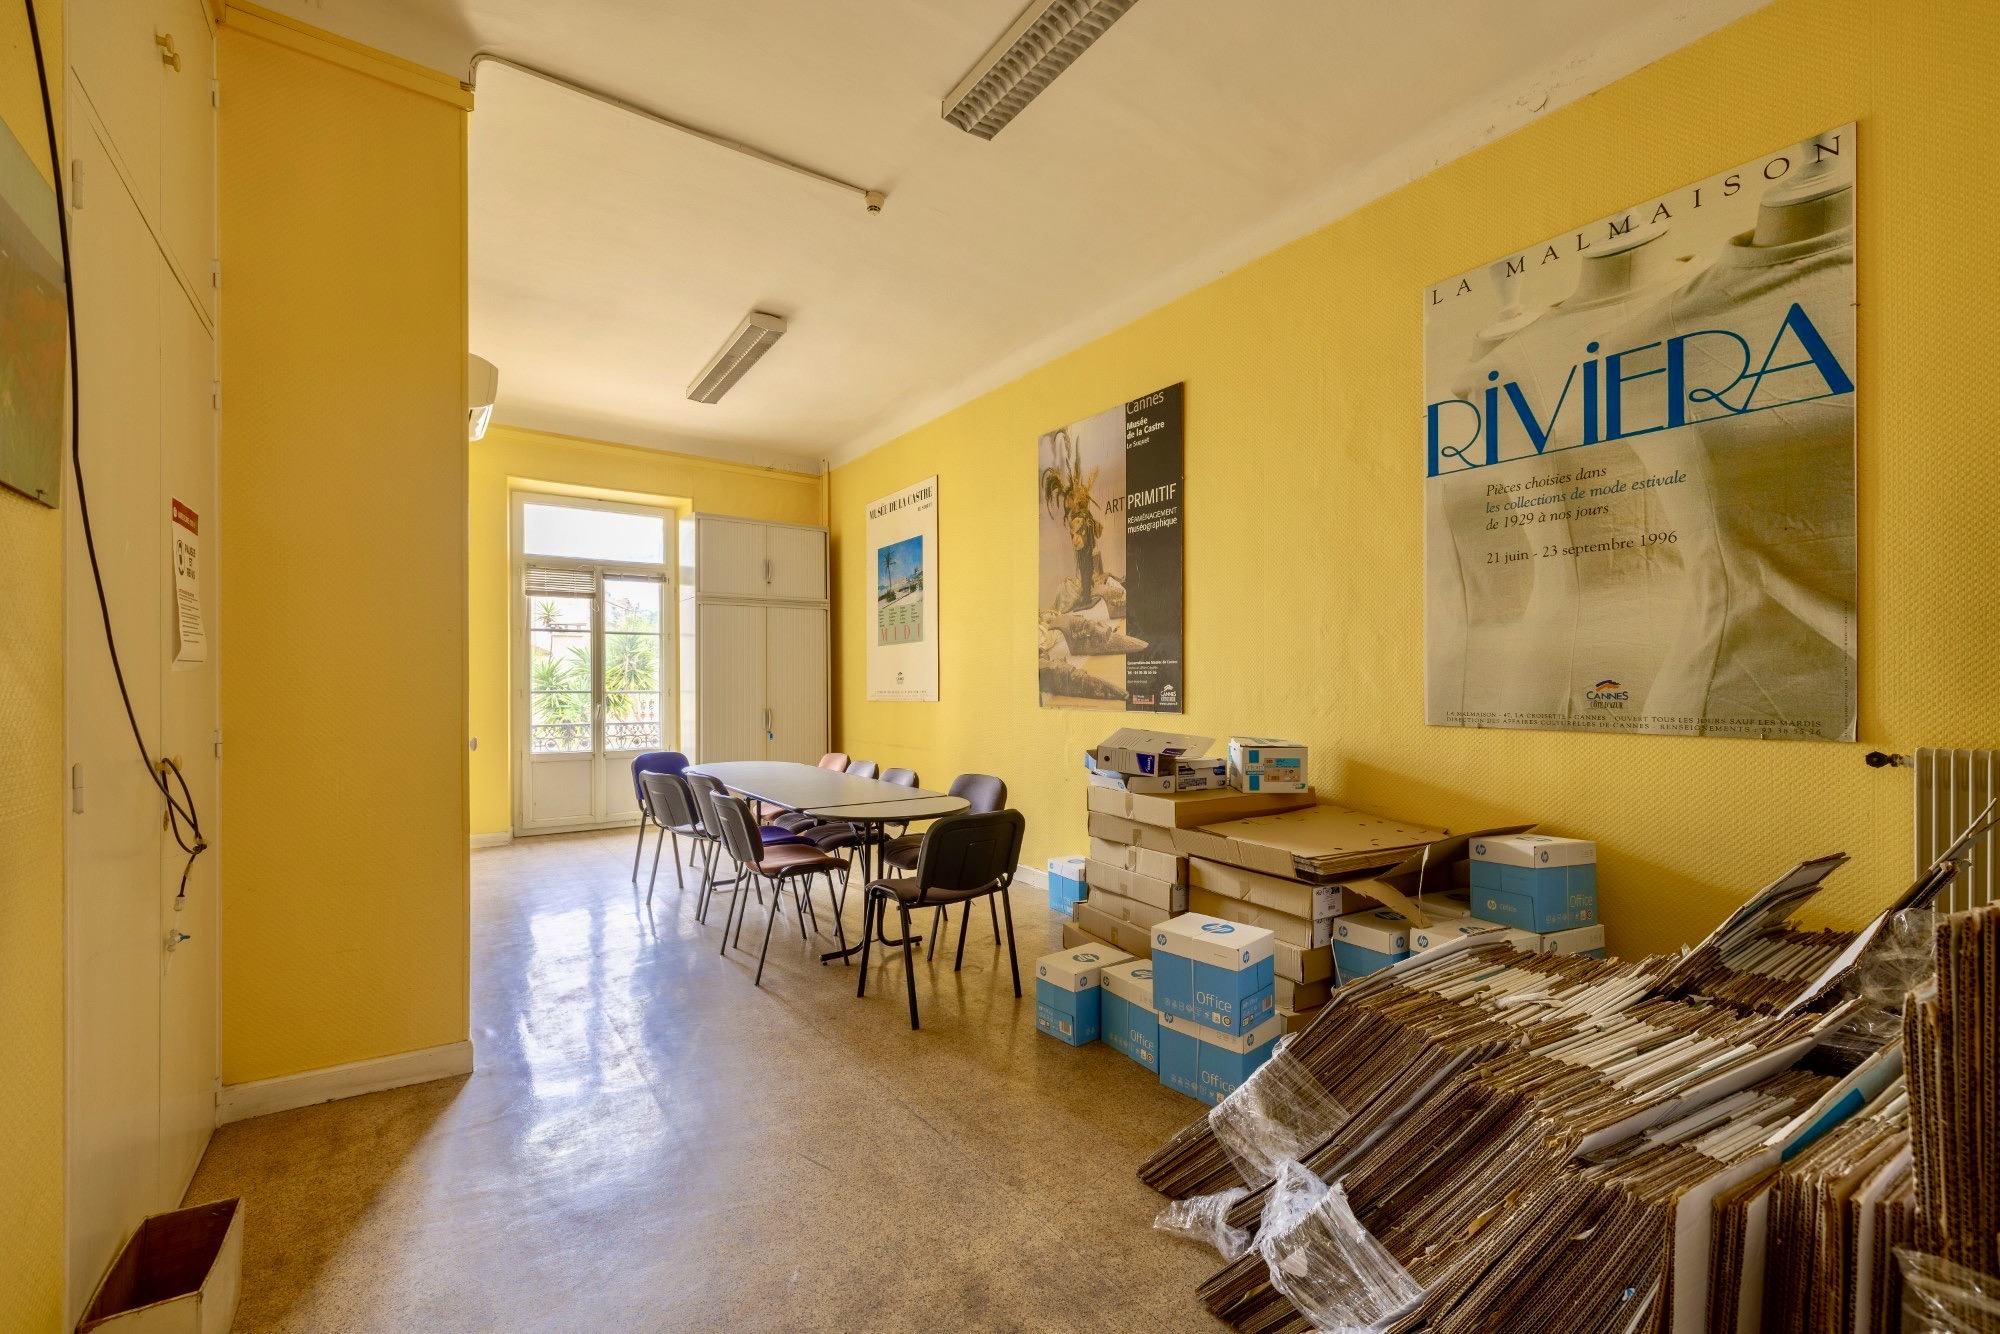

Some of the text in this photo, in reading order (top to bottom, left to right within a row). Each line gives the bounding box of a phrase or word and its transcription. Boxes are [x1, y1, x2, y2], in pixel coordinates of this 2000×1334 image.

[1432, 135, 1842, 305] LA MALMAISON
[1126, 391, 1164, 414] Cannes
[1126, 416, 1148, 430] Musée
[1126, 420, 1165, 440] de la Castre
[1486, 466, 1607, 496] Pièces choisies dans
[1105, 482, 1176, 515] ART PRIMITIF
[1486, 470, 1687, 514] les collections de mode estivale
[870, 486, 932, 520] MUSÉE DE LA CASTRE
[1127, 506, 1178, 524] RÉAMÉNAGEMENT
[1127, 517, 1178, 534] muséographique
[1486, 504, 1610, 530] de 1929 à nos jours
[1486, 552, 1500, 564] 21
[1504, 550, 1530, 564] juin
[1542, 546, 1558, 558] 23
[1562, 538, 1634, 557] septembre
[1640, 530, 1678, 547] 1996
[1586, 691, 1629, 700] CANNES
[1540, 720, 1596, 728] CULTURELLES
[1660, 724, 1750, 733] RENSEIGNEMENTS
[1780, 720, 1822, 728] MARDIS
[1570, 894, 1593, 908] Office
[1157, 934, 1167, 946] hp
[1417, 935, 1428, 948] hp
[1196, 991, 1232, 1012] Office
[1130, 1029, 1154, 1051] Office
[1201, 1070, 1236, 1093] Office
